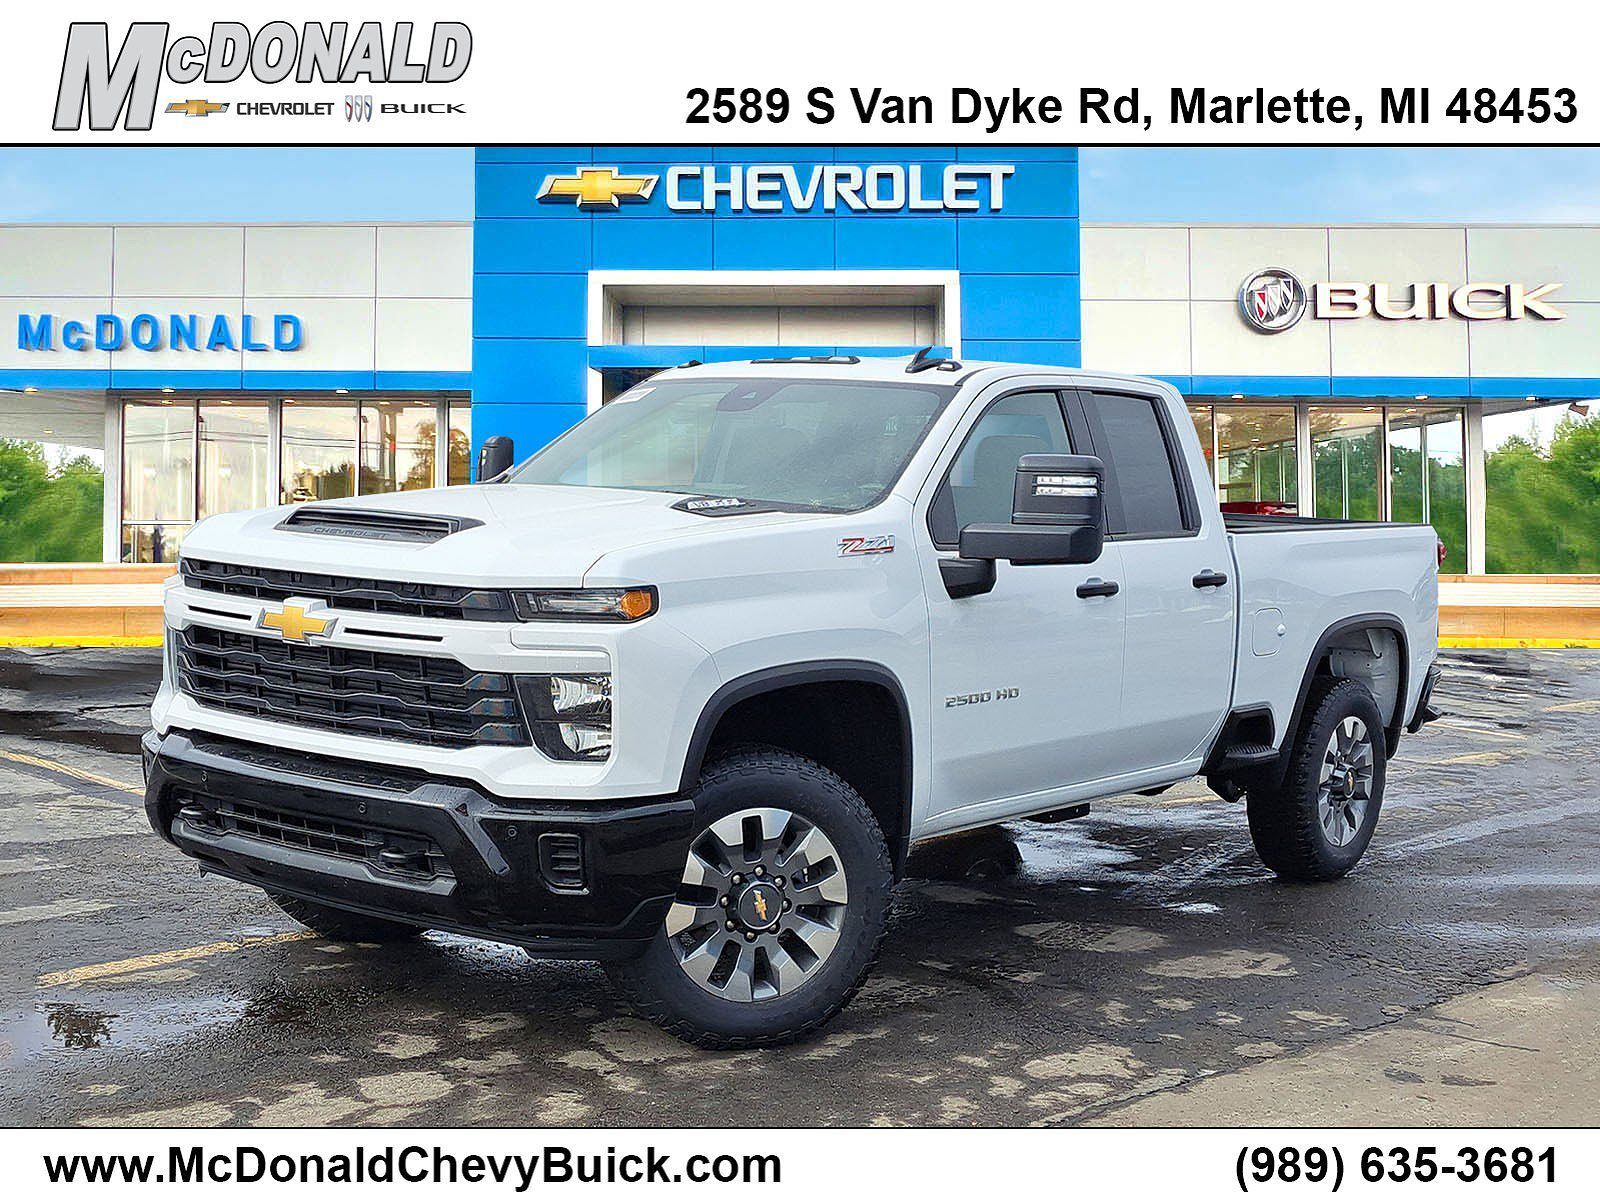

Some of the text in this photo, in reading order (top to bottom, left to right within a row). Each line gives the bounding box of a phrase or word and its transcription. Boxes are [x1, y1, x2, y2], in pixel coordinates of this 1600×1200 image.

[666, 164, 1015, 211] CHEVROLET
[1313, 281, 1567, 321] BUICK
[17, 314, 305, 352] McDONALD
[945, 687, 1019, 708] 2500 HD
